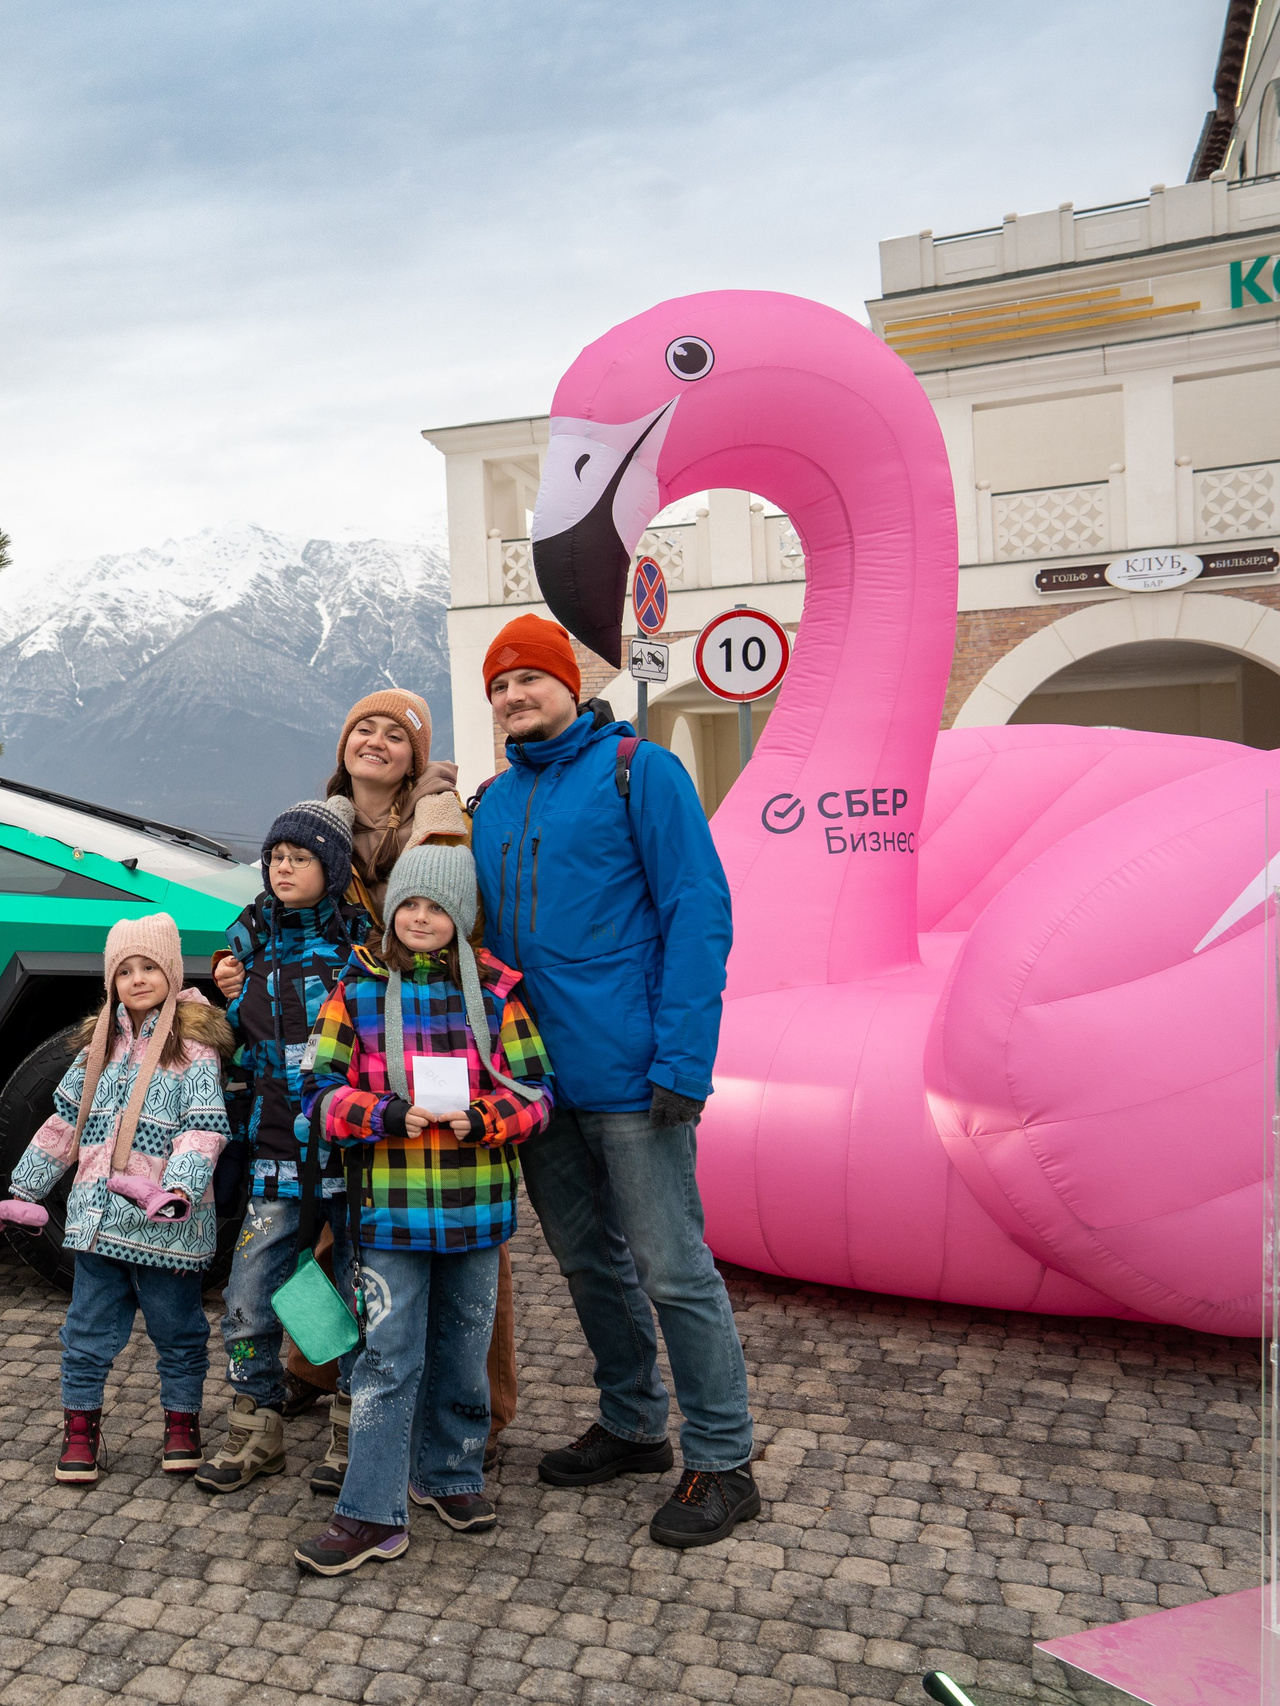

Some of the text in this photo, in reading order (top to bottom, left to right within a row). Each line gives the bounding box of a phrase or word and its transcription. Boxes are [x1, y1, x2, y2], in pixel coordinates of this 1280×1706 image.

[1230, 255, 1280, 309] К
[1125, 554, 1182, 573] КЛУБ
[1215, 554, 1269, 568] БИЛЬЯРД
[1052, 572, 1088, 583] ГОЛЬФ
[1143, 579, 1164, 588] БАР
[718, 636, 767, 672] 10
[817, 788, 908, 819] СБЕР
[824, 826, 915, 854] Бизнес
